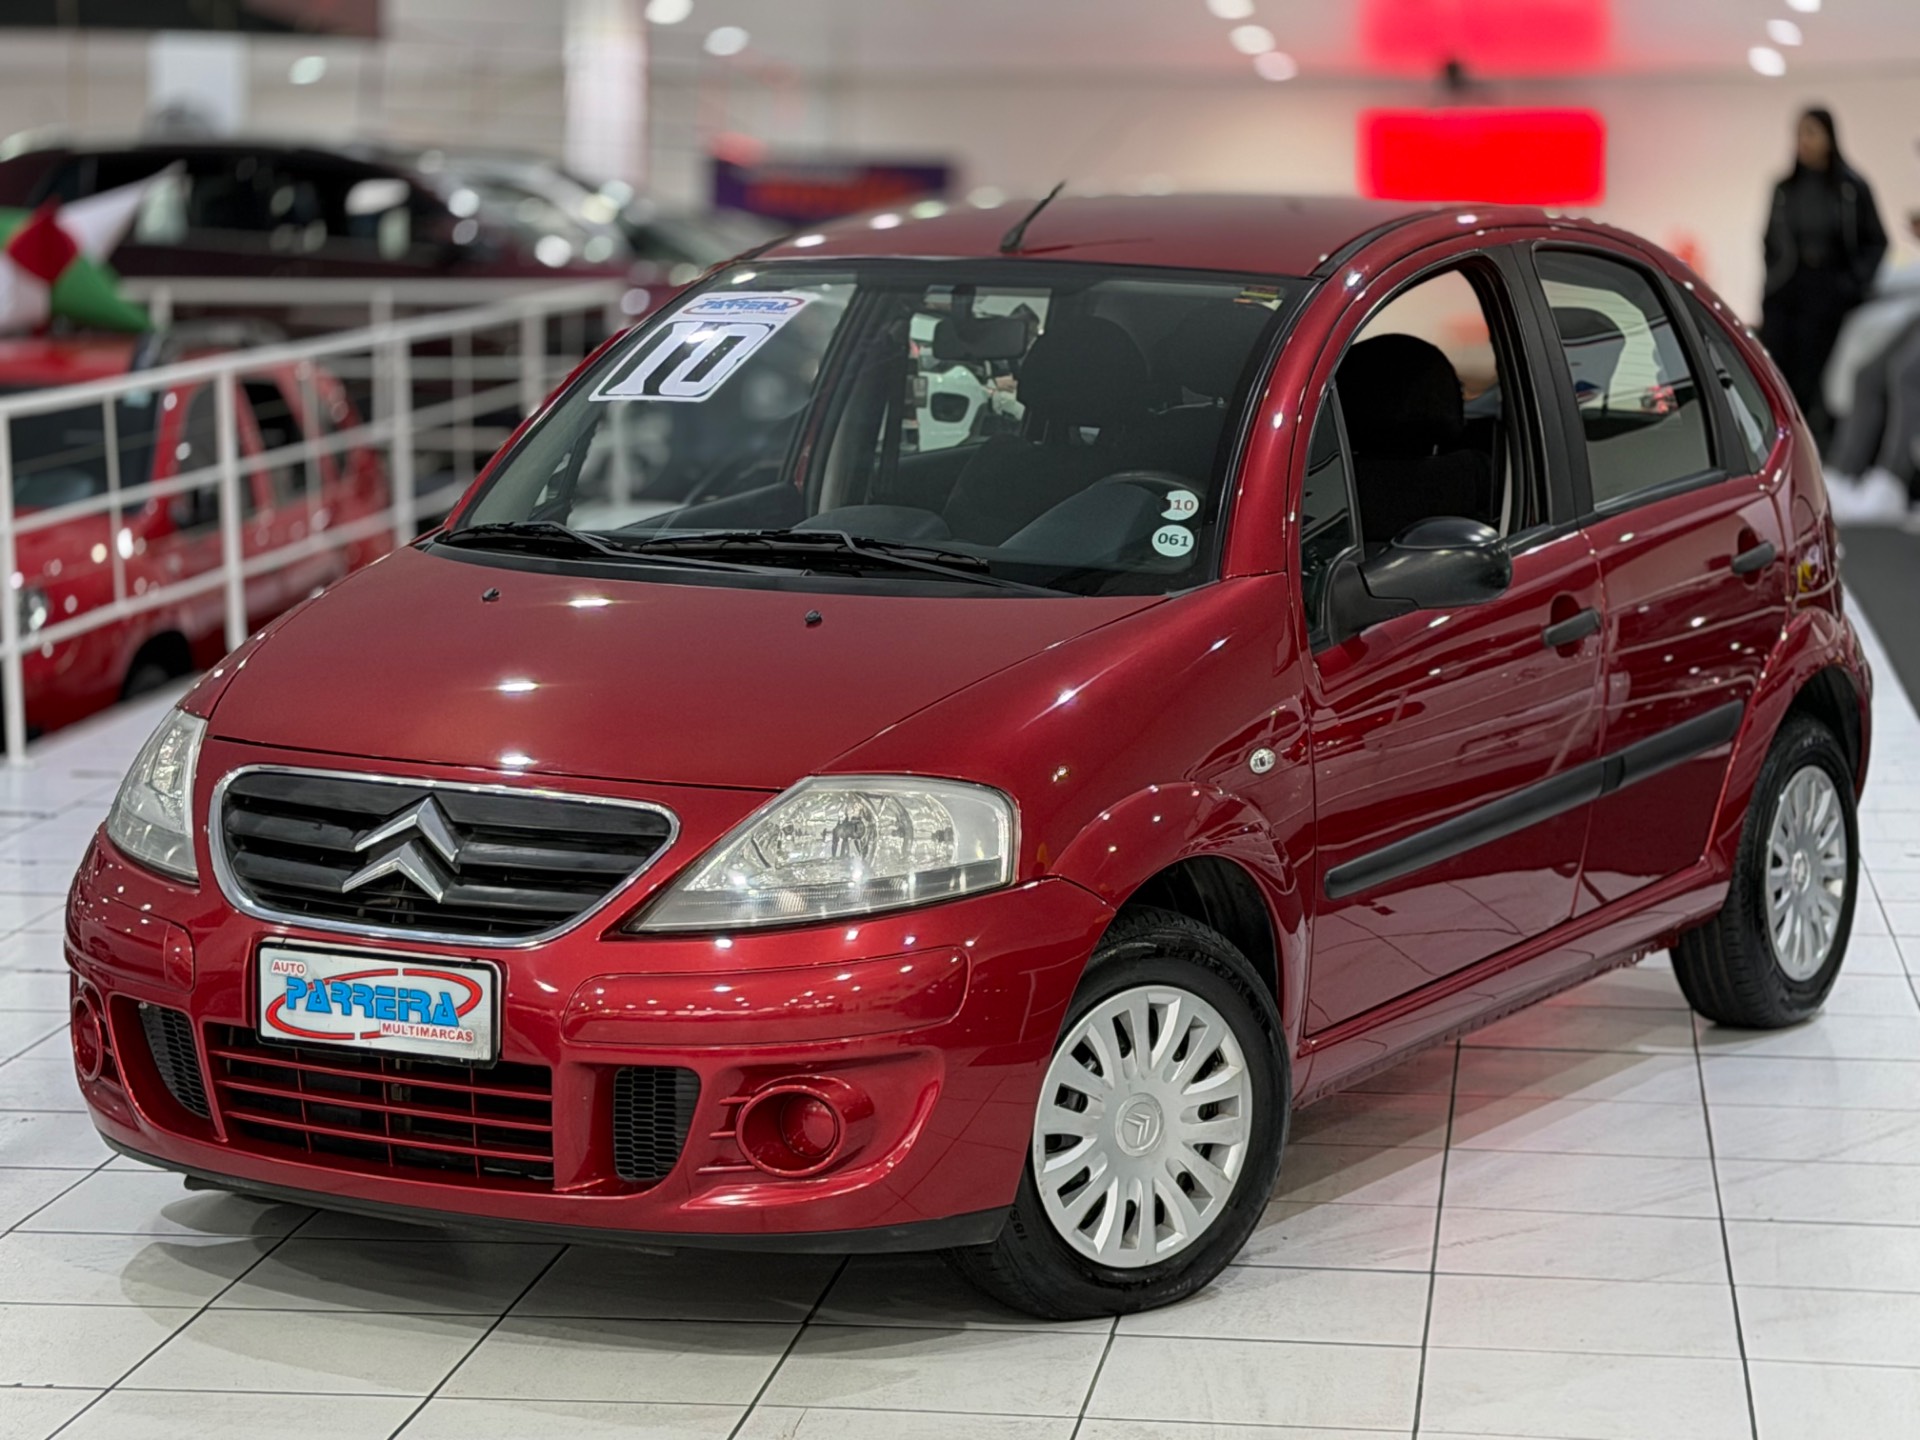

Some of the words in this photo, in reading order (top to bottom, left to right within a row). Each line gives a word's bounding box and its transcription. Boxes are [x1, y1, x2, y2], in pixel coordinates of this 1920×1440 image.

[605, 321, 772, 396] 10
[1173, 499, 1195, 512] 10
[1157, 532, 1190, 548] 061
[272, 961, 305, 974] AUTO
[286, 976, 460, 1027] PARREIRA
[382, 1022, 474, 1042] MULTIMARCAS
